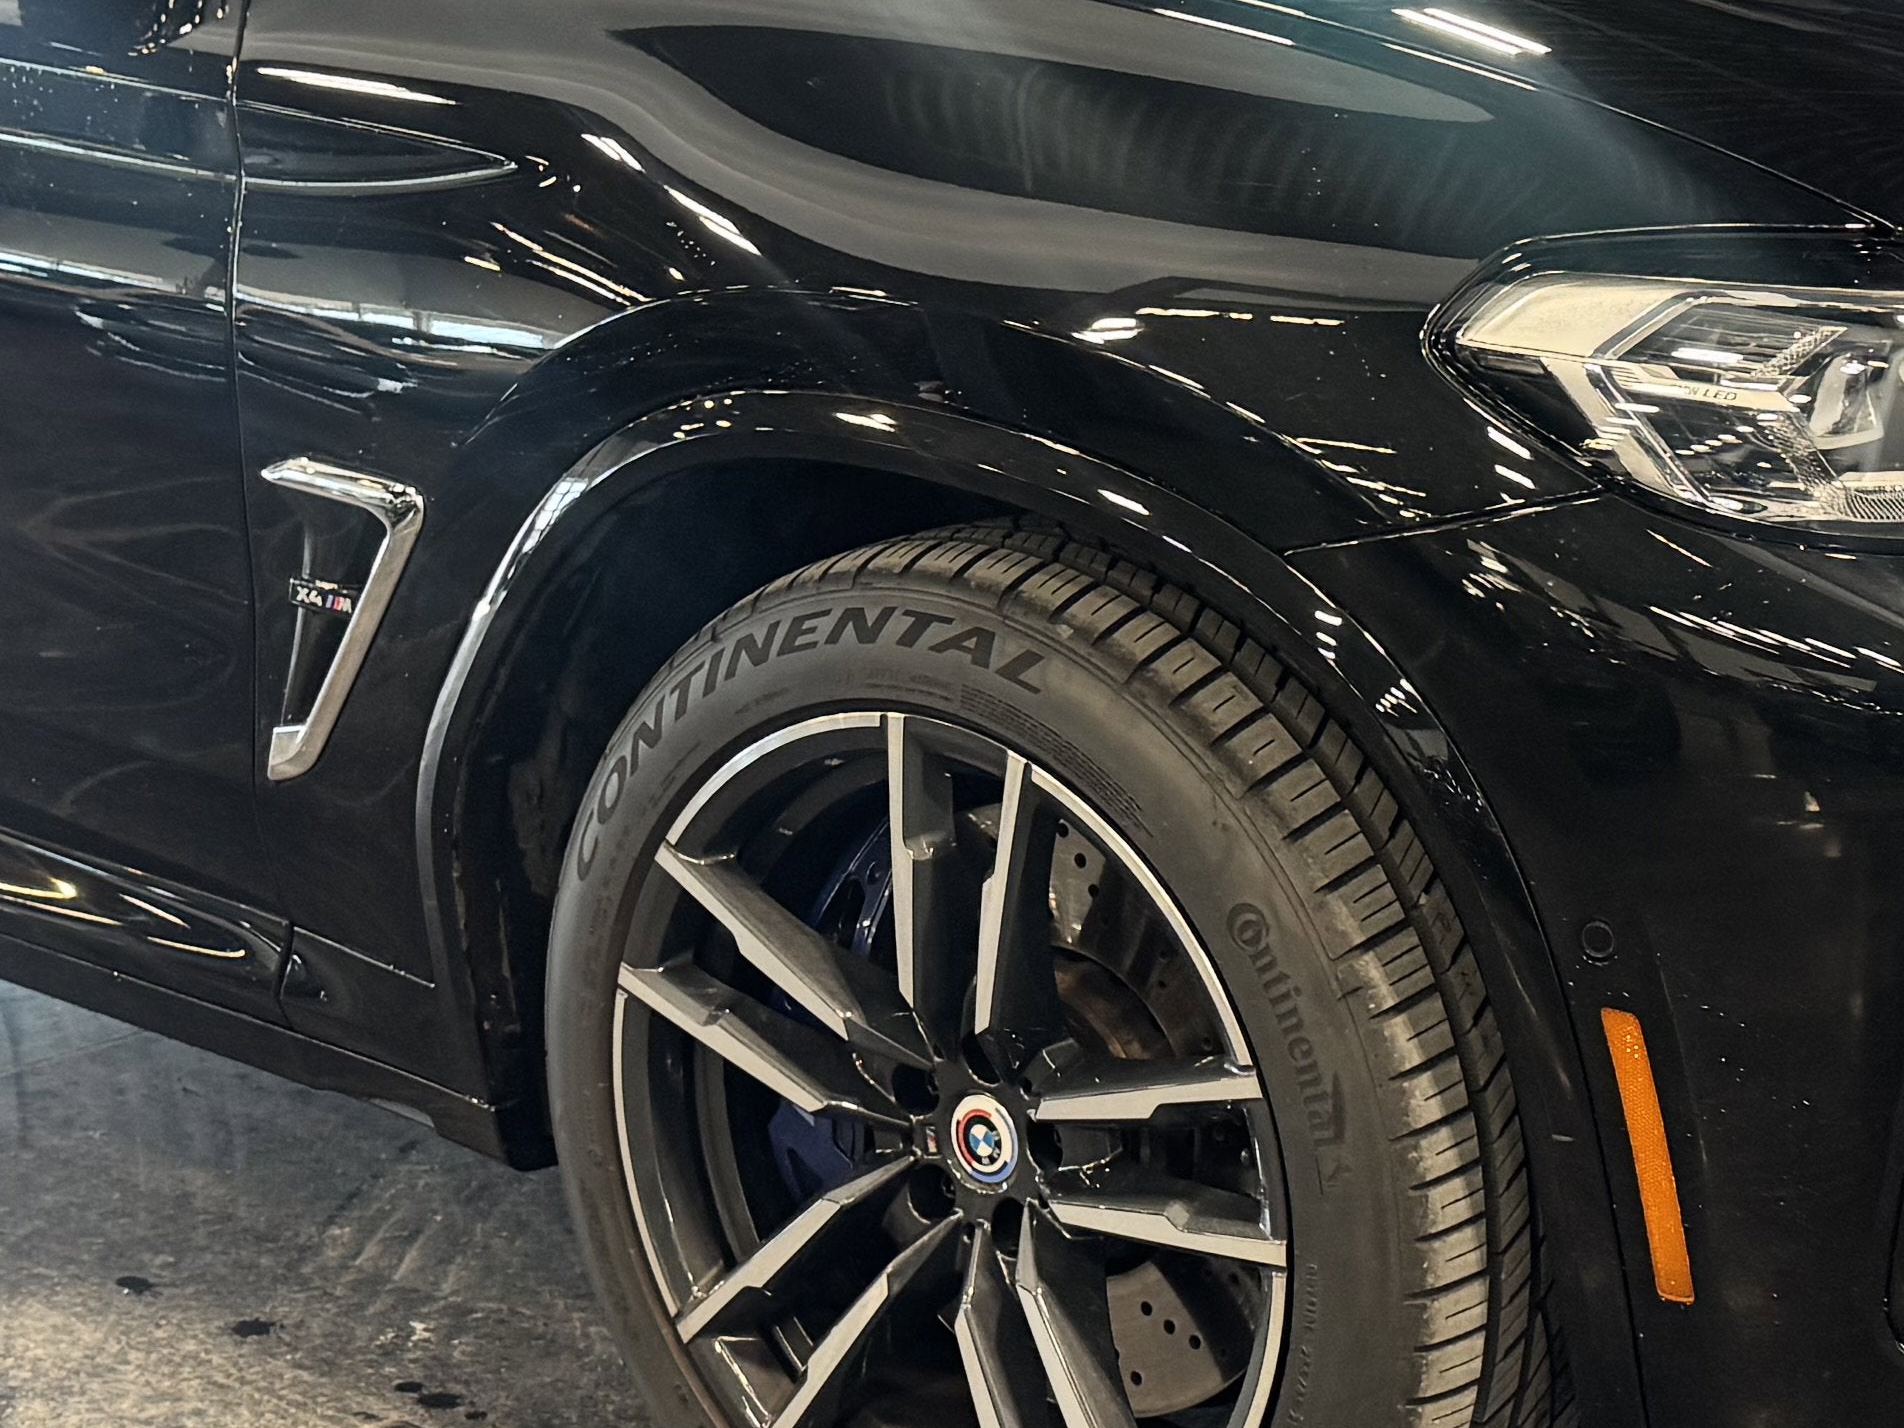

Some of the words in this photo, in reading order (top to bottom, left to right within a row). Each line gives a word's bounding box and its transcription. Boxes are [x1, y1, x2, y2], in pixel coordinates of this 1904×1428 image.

[296, 586, 322, 607] X4
[577, 606, 1044, 881] CONTINENTAL
[1226, 902, 1343, 1148] Continental
